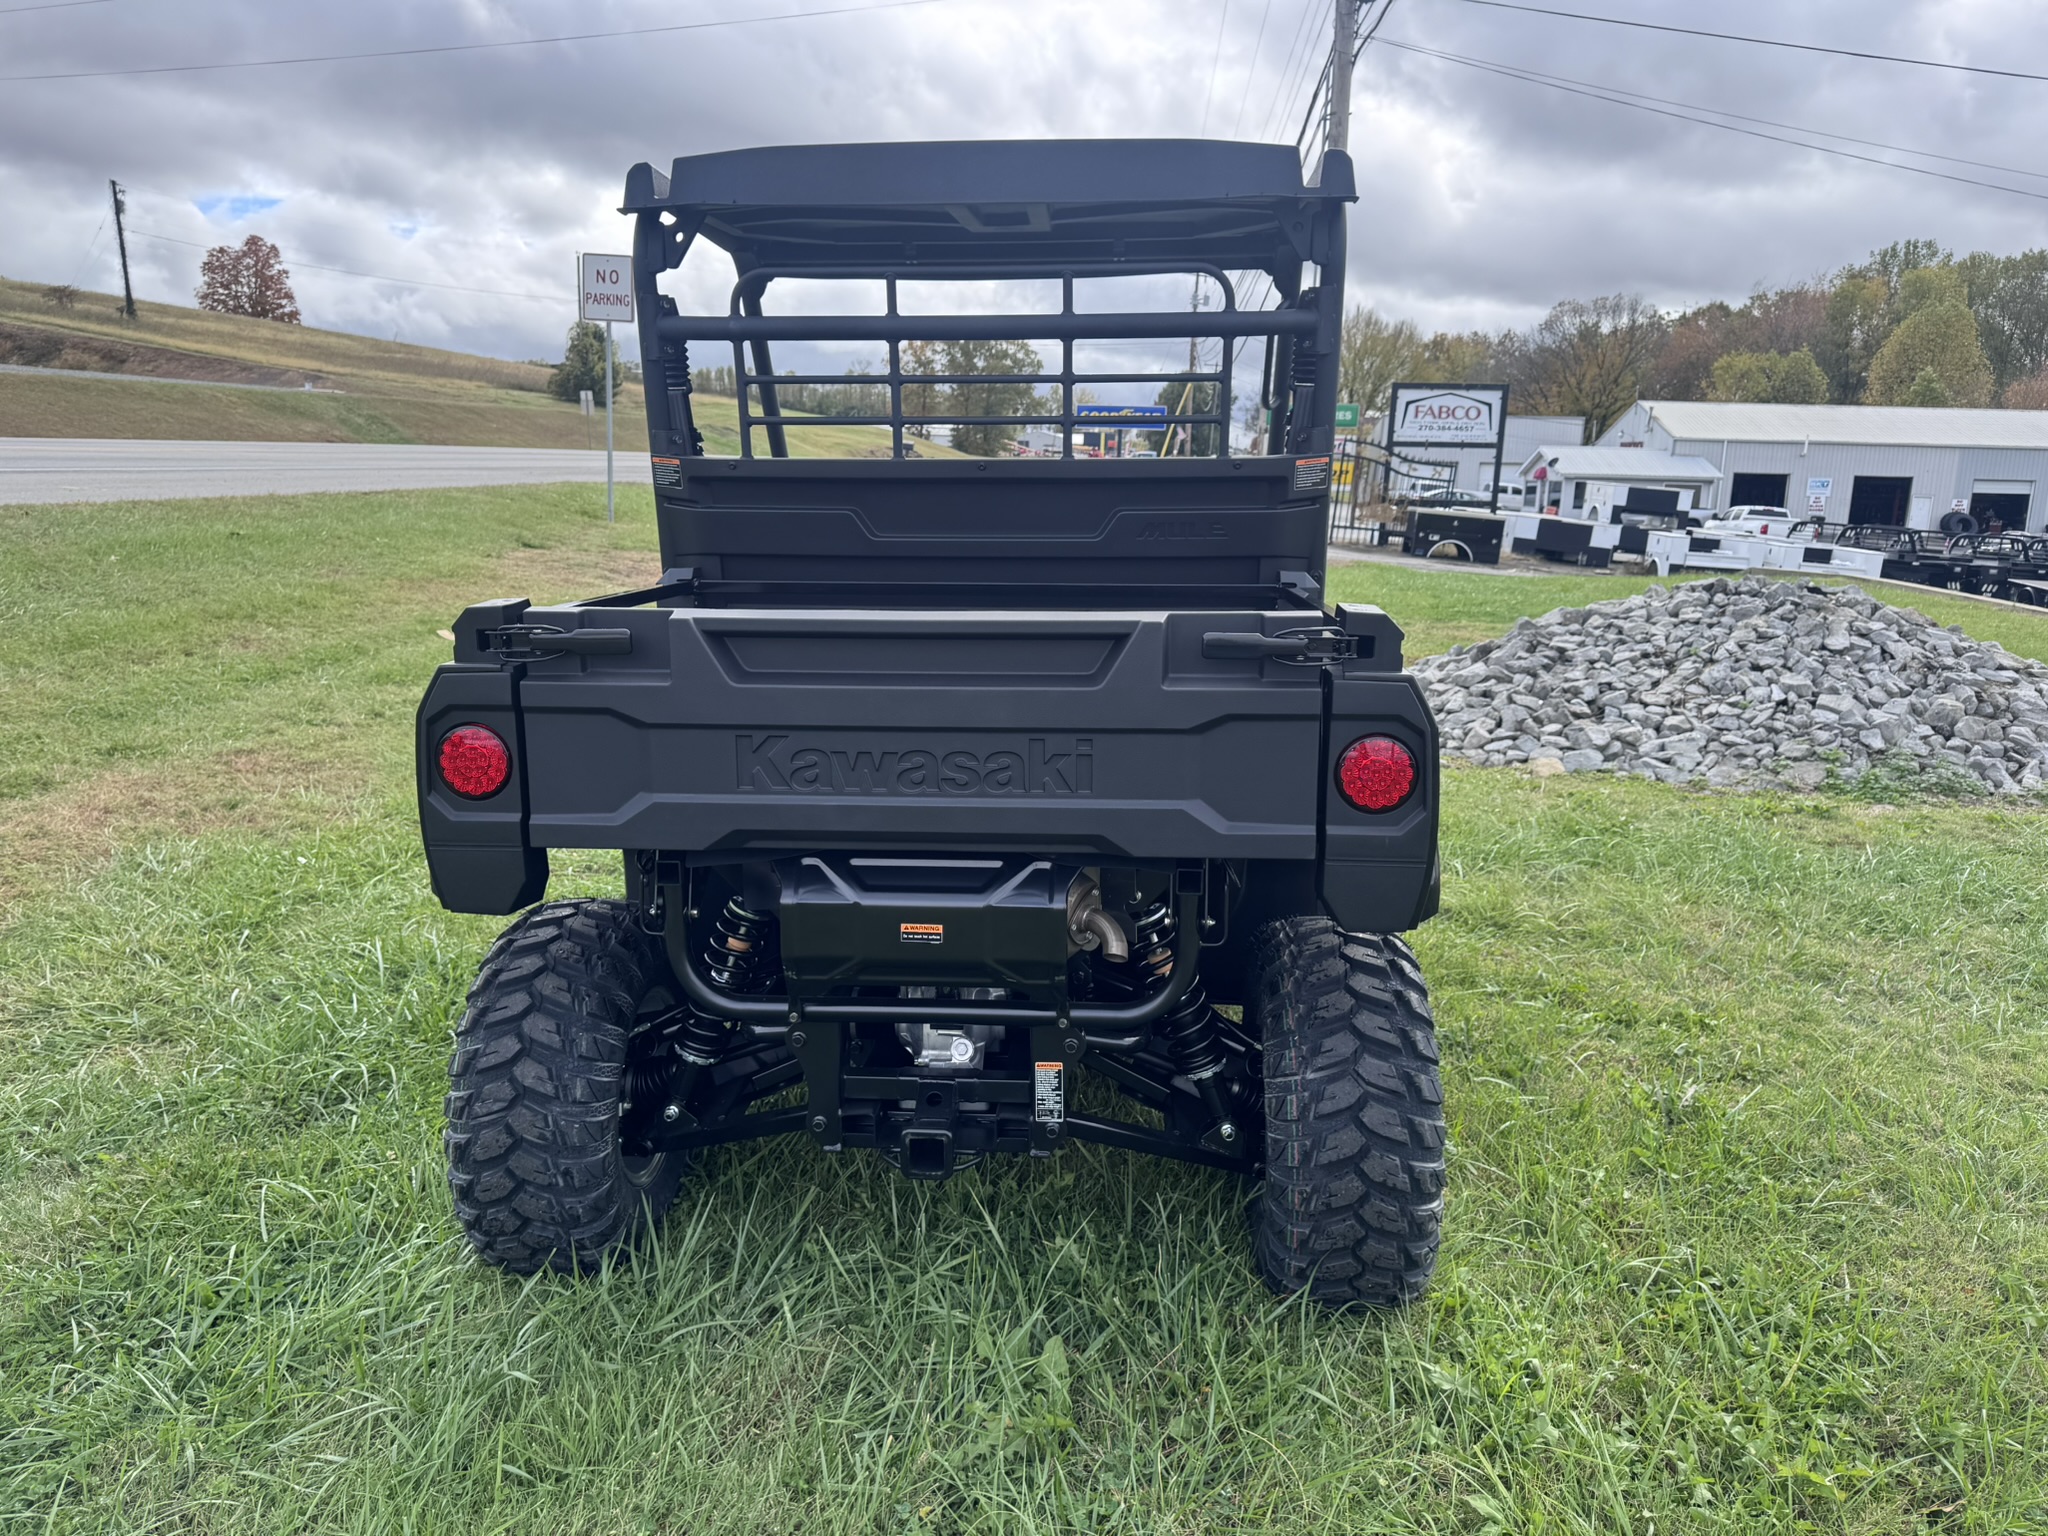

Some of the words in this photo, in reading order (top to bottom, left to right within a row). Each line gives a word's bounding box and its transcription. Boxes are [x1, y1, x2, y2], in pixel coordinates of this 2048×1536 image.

[596, 268, 619, 284] NO
[585, 292, 630, 307] PARKING
[1413, 404, 1481, 420] FABCO
[1136, 521, 1230, 540] MULE
[735, 734, 1093, 794] Kawasaki
